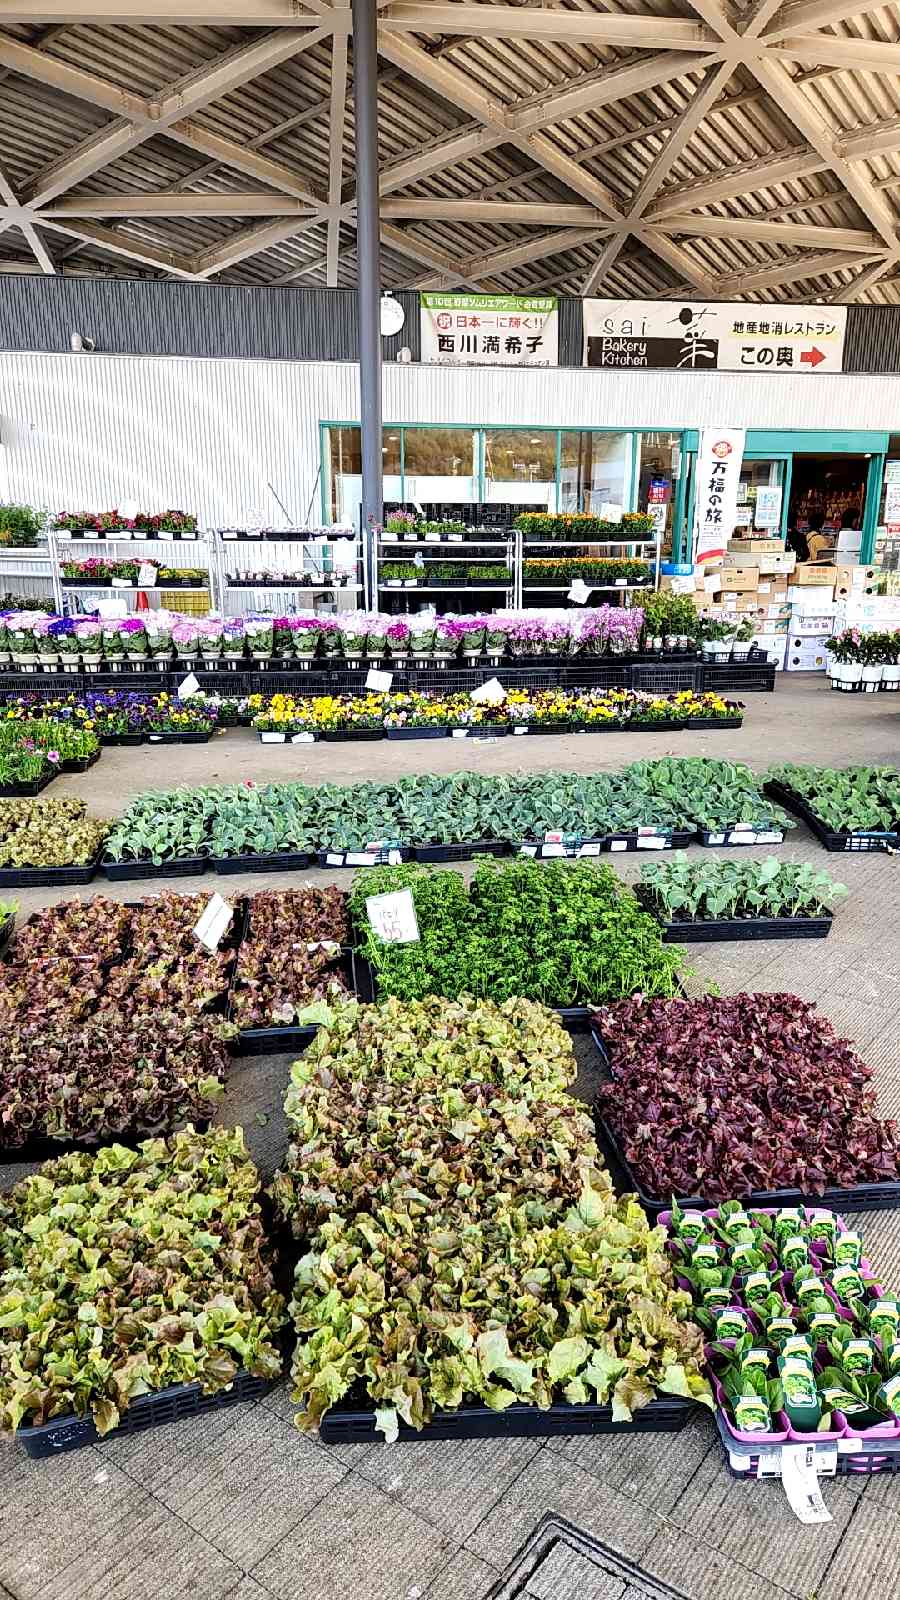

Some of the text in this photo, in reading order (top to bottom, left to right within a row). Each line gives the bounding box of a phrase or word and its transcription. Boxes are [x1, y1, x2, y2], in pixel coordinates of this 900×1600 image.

[602, 316, 647, 336] sai
[732, 321, 836, 336] 地産地消レストラン
[437, 333, 544, 354] 西川満希子
[602, 338, 647, 355] Bakery
[601, 352, 648, 366] Kitchen
[740, 346, 794, 367] この奥
[705, 461, 729, 523] 万福の旅
